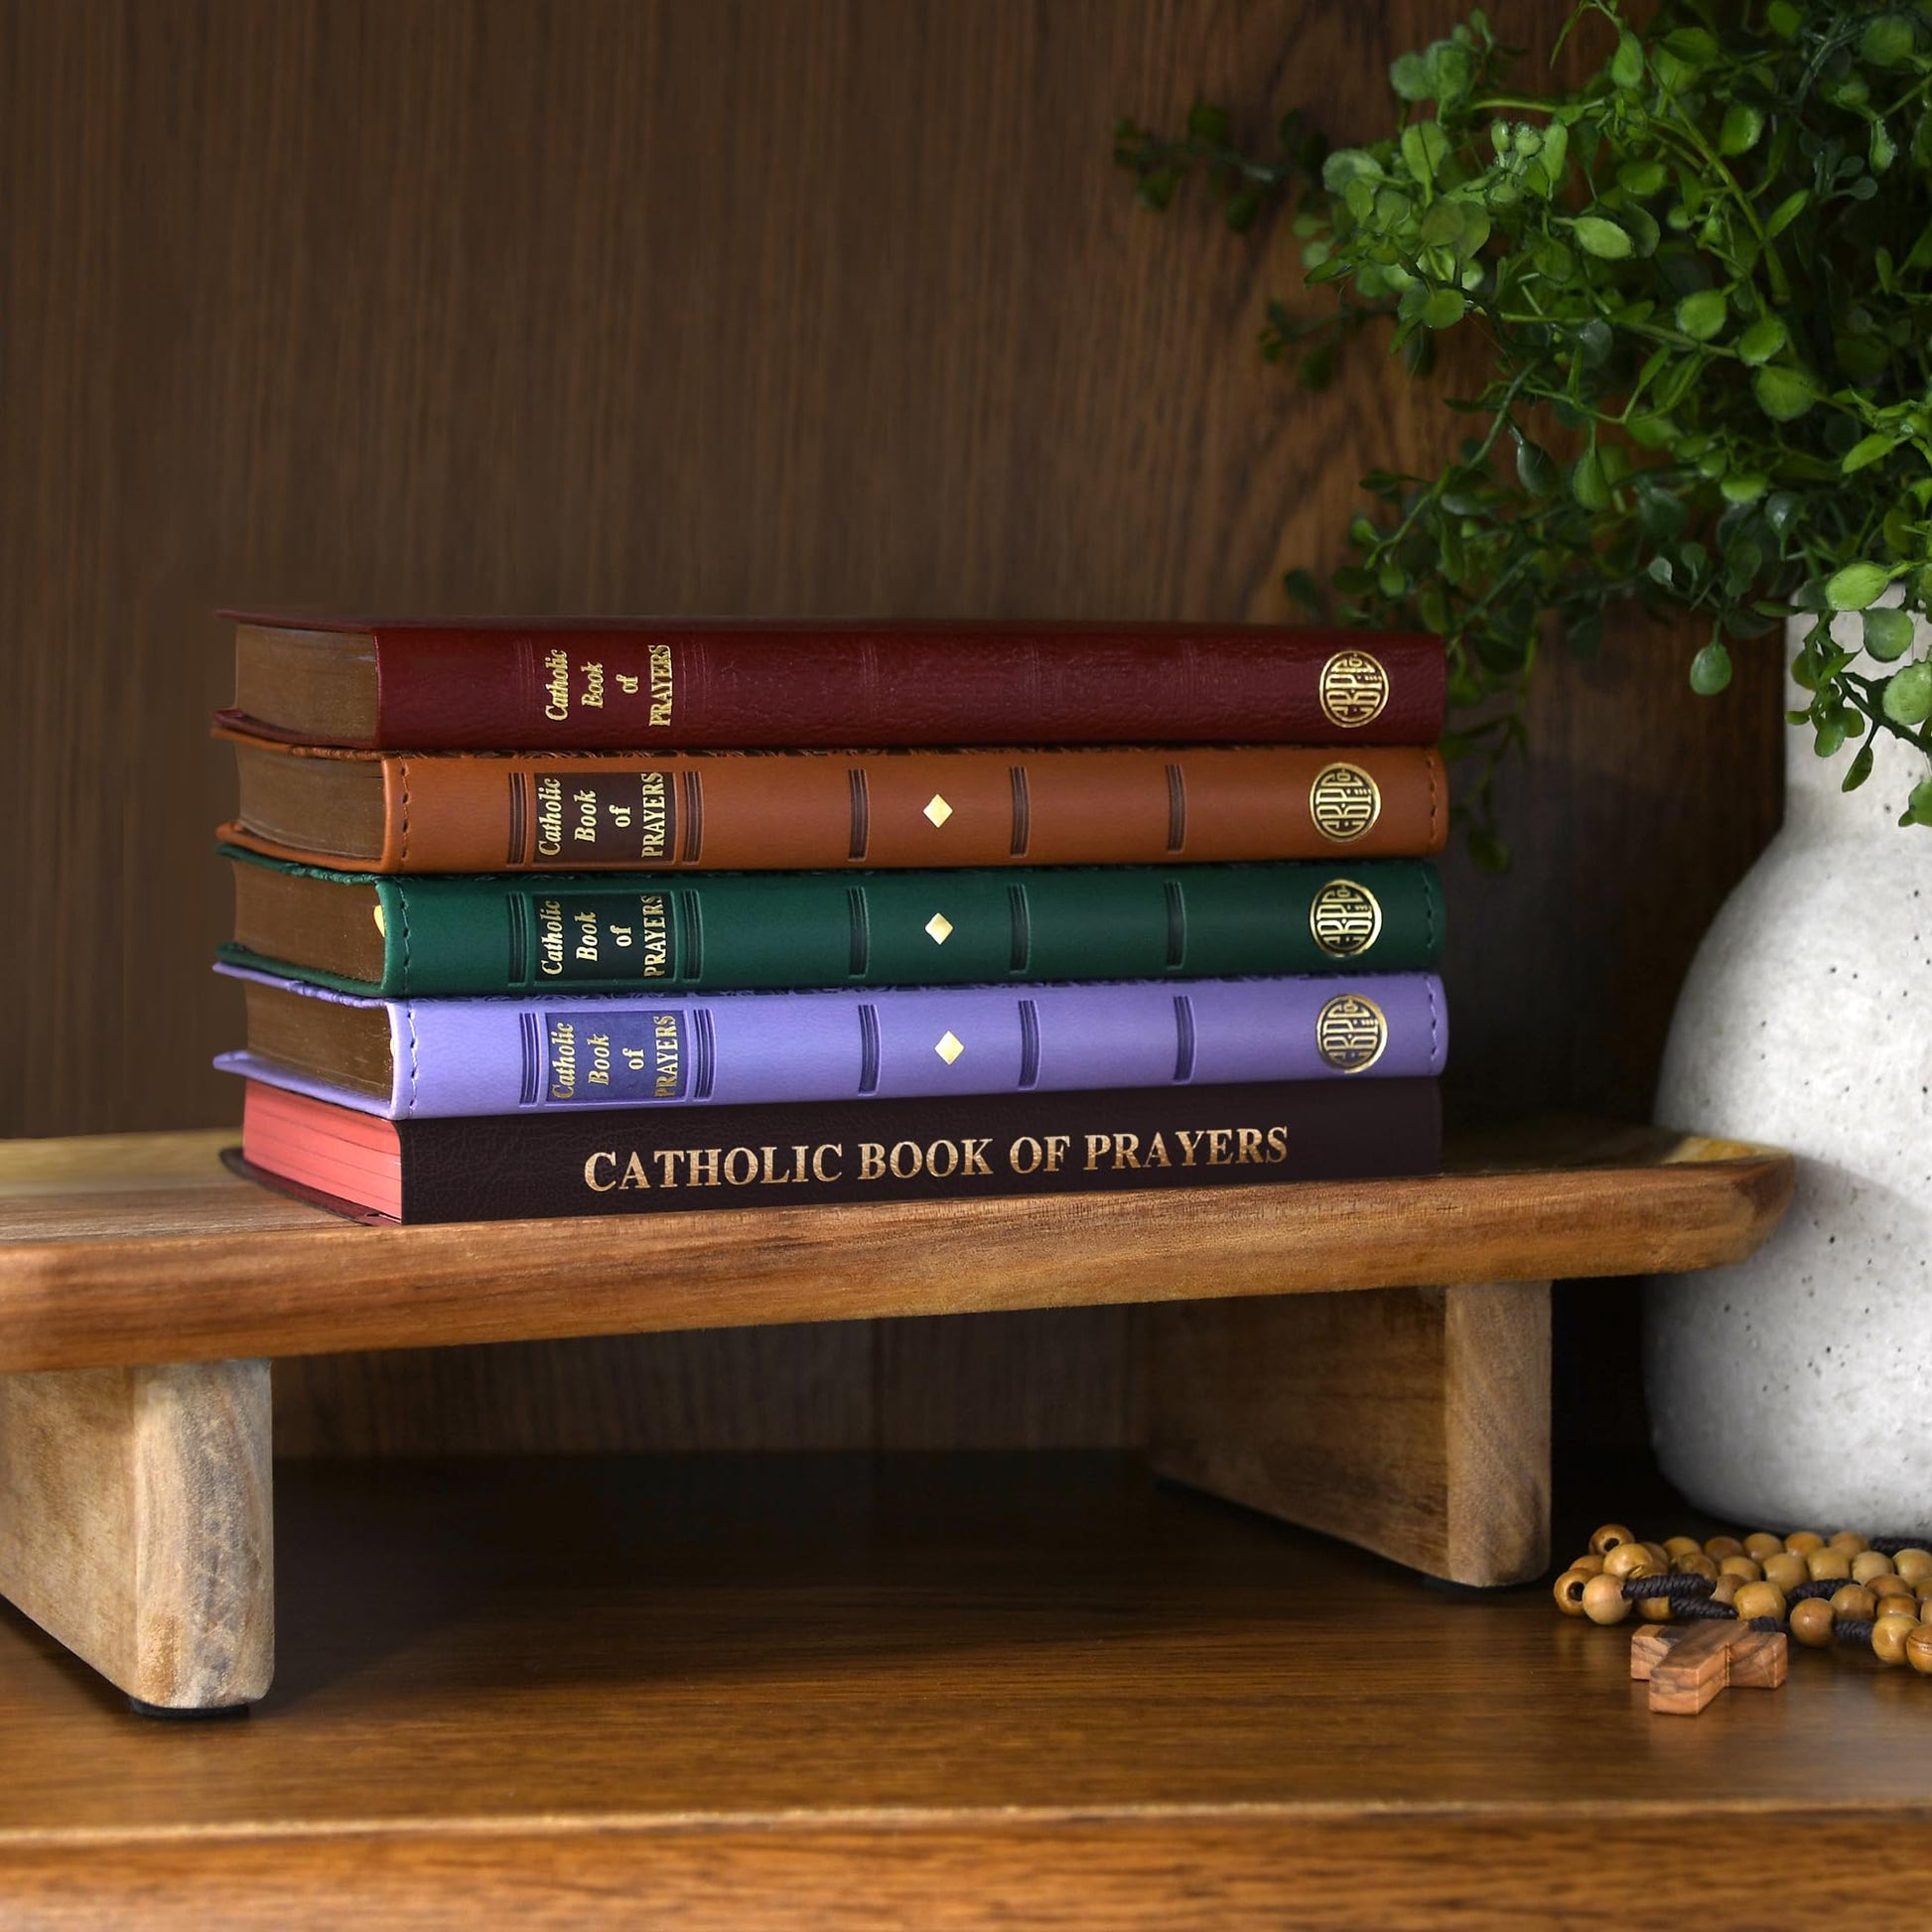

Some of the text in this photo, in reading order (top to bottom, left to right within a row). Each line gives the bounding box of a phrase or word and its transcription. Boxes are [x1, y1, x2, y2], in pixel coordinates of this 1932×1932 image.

[545, 649, 569, 721] Catholic
[581, 661, 604, 709] Book
[617, 674, 639, 694] of
[647, 644, 673, 727] PRAYERS
[538, 778, 562, 856] Catholic
[574, 790, 597, 843] Book
[609, 804, 630, 828] of
[641, 772, 665, 858] PRAYERS
[540, 899, 563, 975] Catholic
[574, 910, 598, 962] Book
[610, 924, 631, 947] of
[640, 895, 666, 977] PRAYERS
[551, 1022, 575, 1099] Catholic
[587, 1033, 611, 1086] Book
[622, 1047, 644, 1070] of
[653, 1015, 678, 1098] PRAYERS
[584, 1125, 1289, 1192] CATHOLIC BOOK OF PRAYERS
